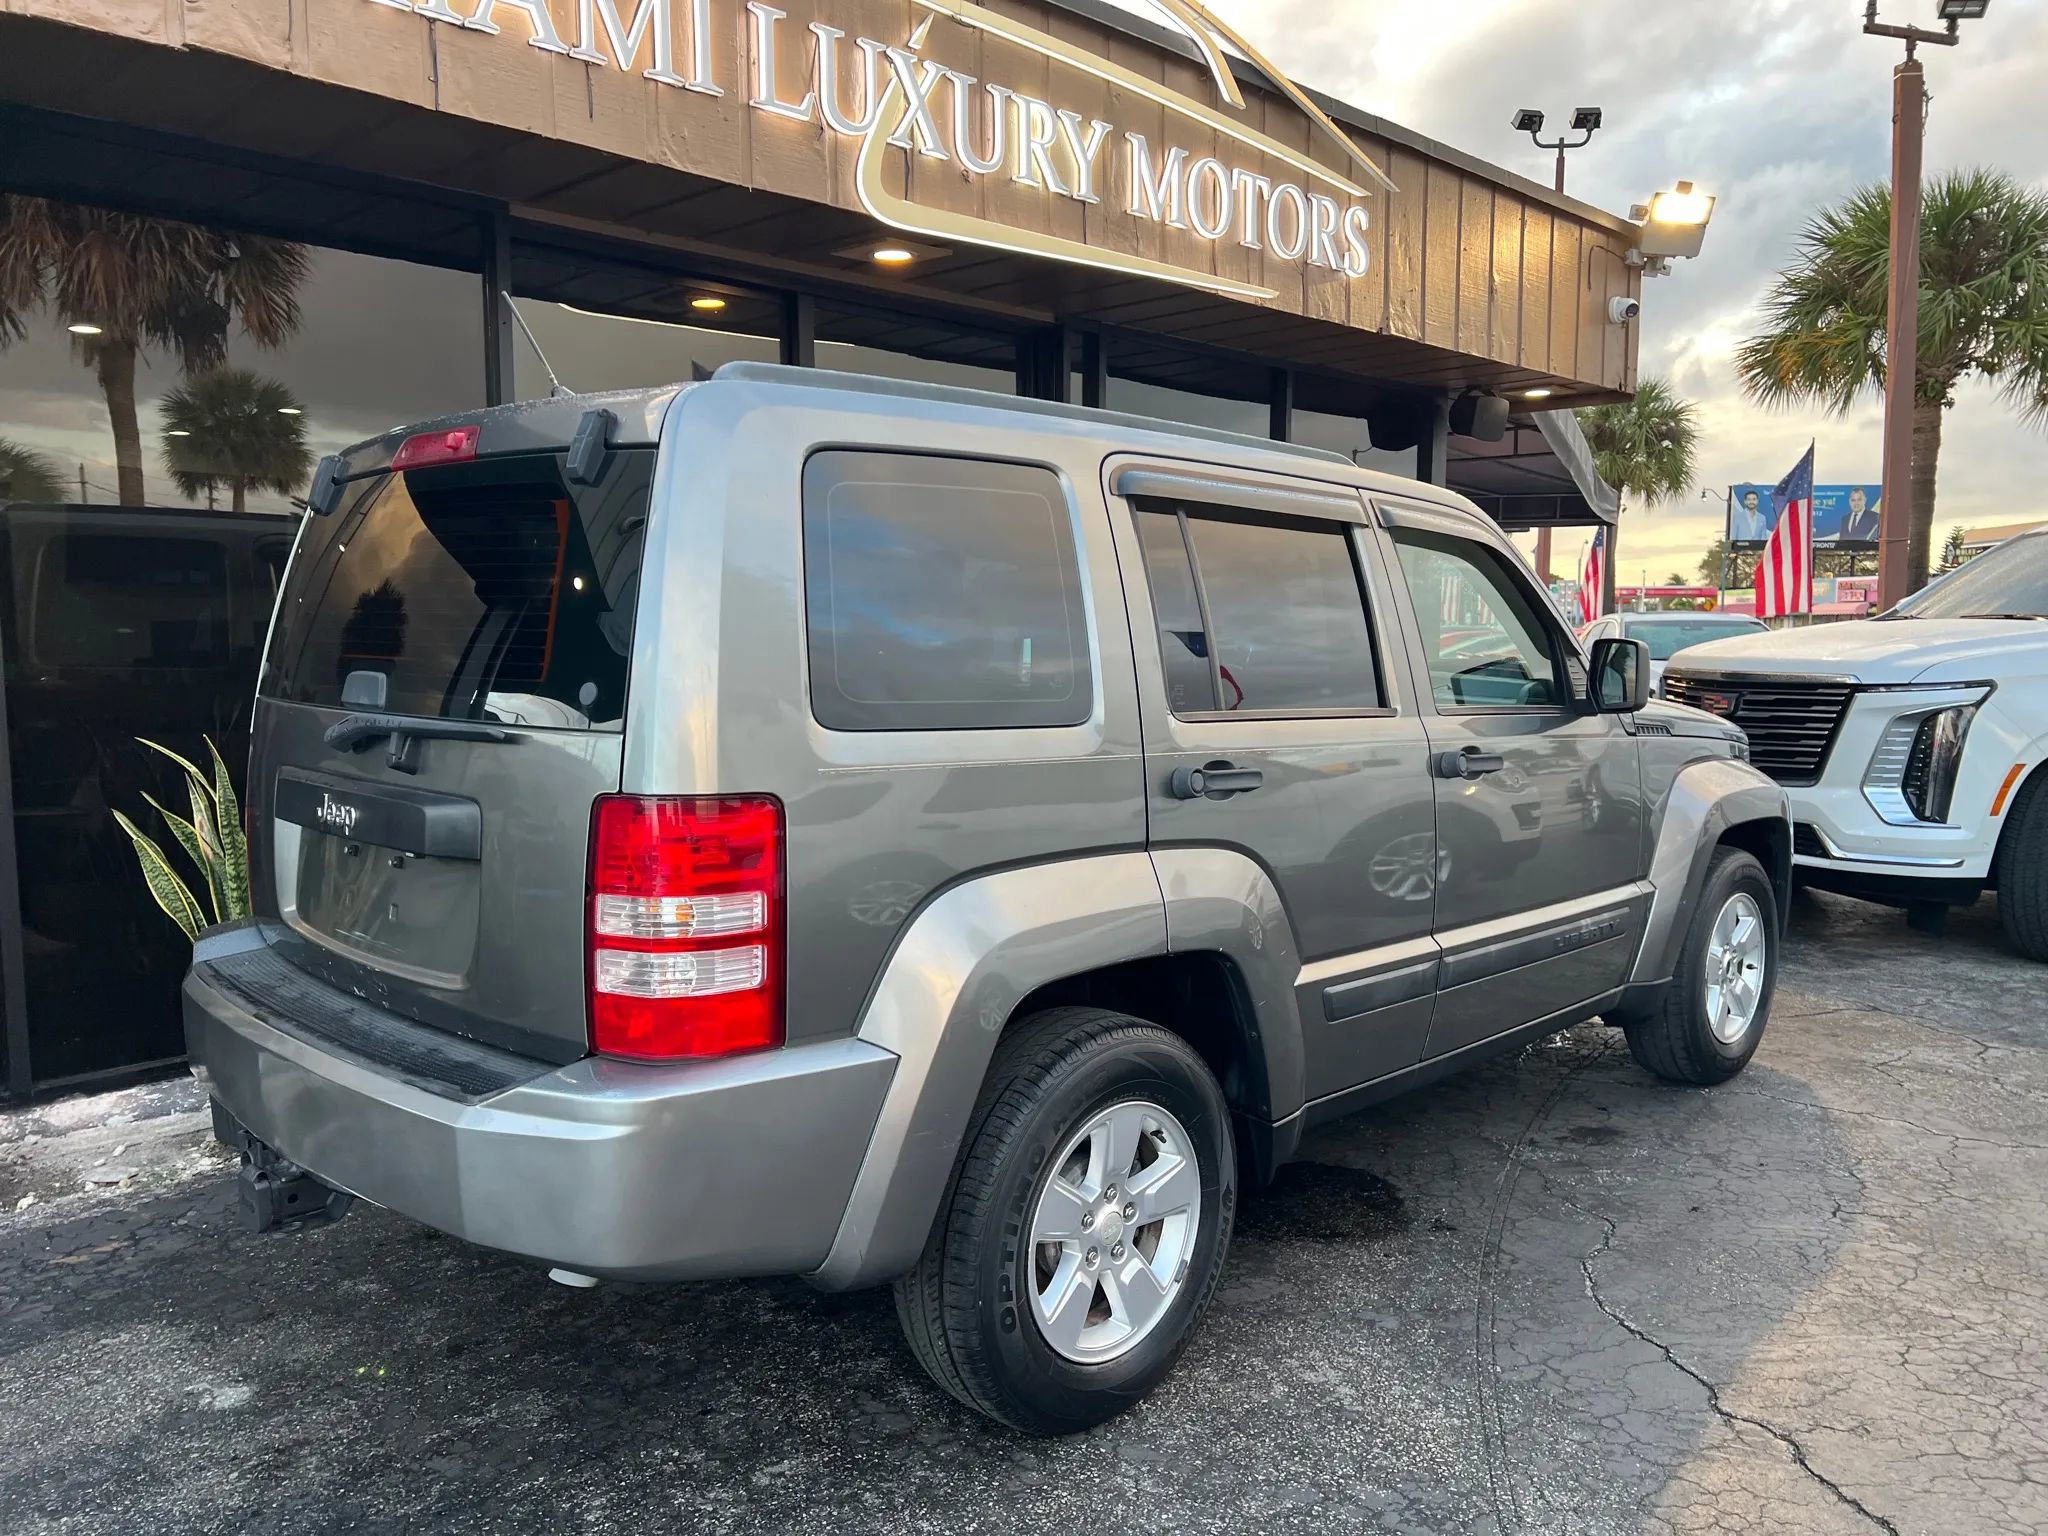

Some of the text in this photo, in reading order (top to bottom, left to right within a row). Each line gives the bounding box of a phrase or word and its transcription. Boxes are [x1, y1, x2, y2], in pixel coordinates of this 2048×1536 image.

[746, 0, 1113, 204] LUXURY
[1125, 131, 1371, 278] MOTORS
[317, 793, 359, 835] Jeep
[1554, 919, 1621, 947] LIBERTY
[998, 1143, 1046, 1335] OPTIMO
